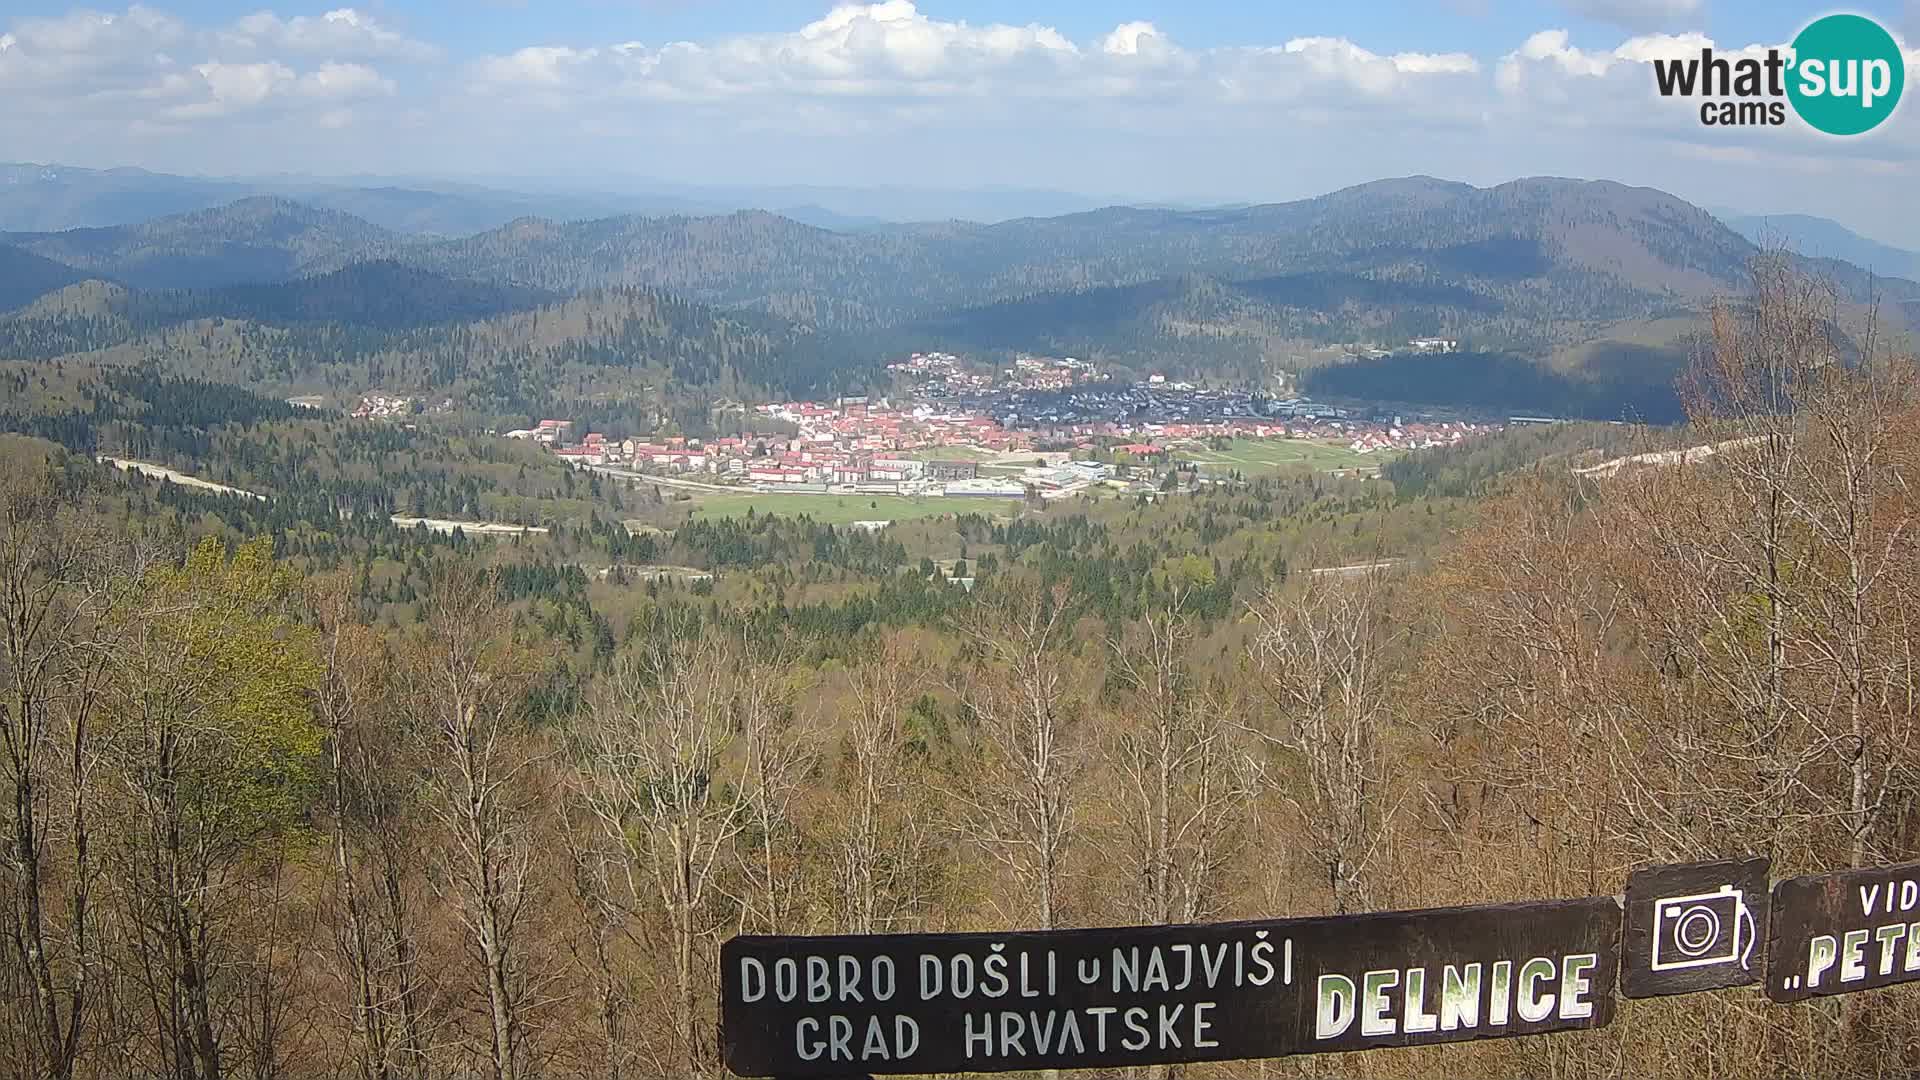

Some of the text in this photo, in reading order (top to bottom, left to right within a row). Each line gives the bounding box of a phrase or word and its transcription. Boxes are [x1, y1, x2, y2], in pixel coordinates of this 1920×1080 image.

[741, 955, 896, 1002] DOBRO
[919, 943, 1057, 1001] DOŠLI
[1112, 931, 1292, 993] NAJVIŠI
[1315, 953, 1597, 1040] DELNICE
[796, 1002, 1220, 1062] GRAD HRVATSKE
